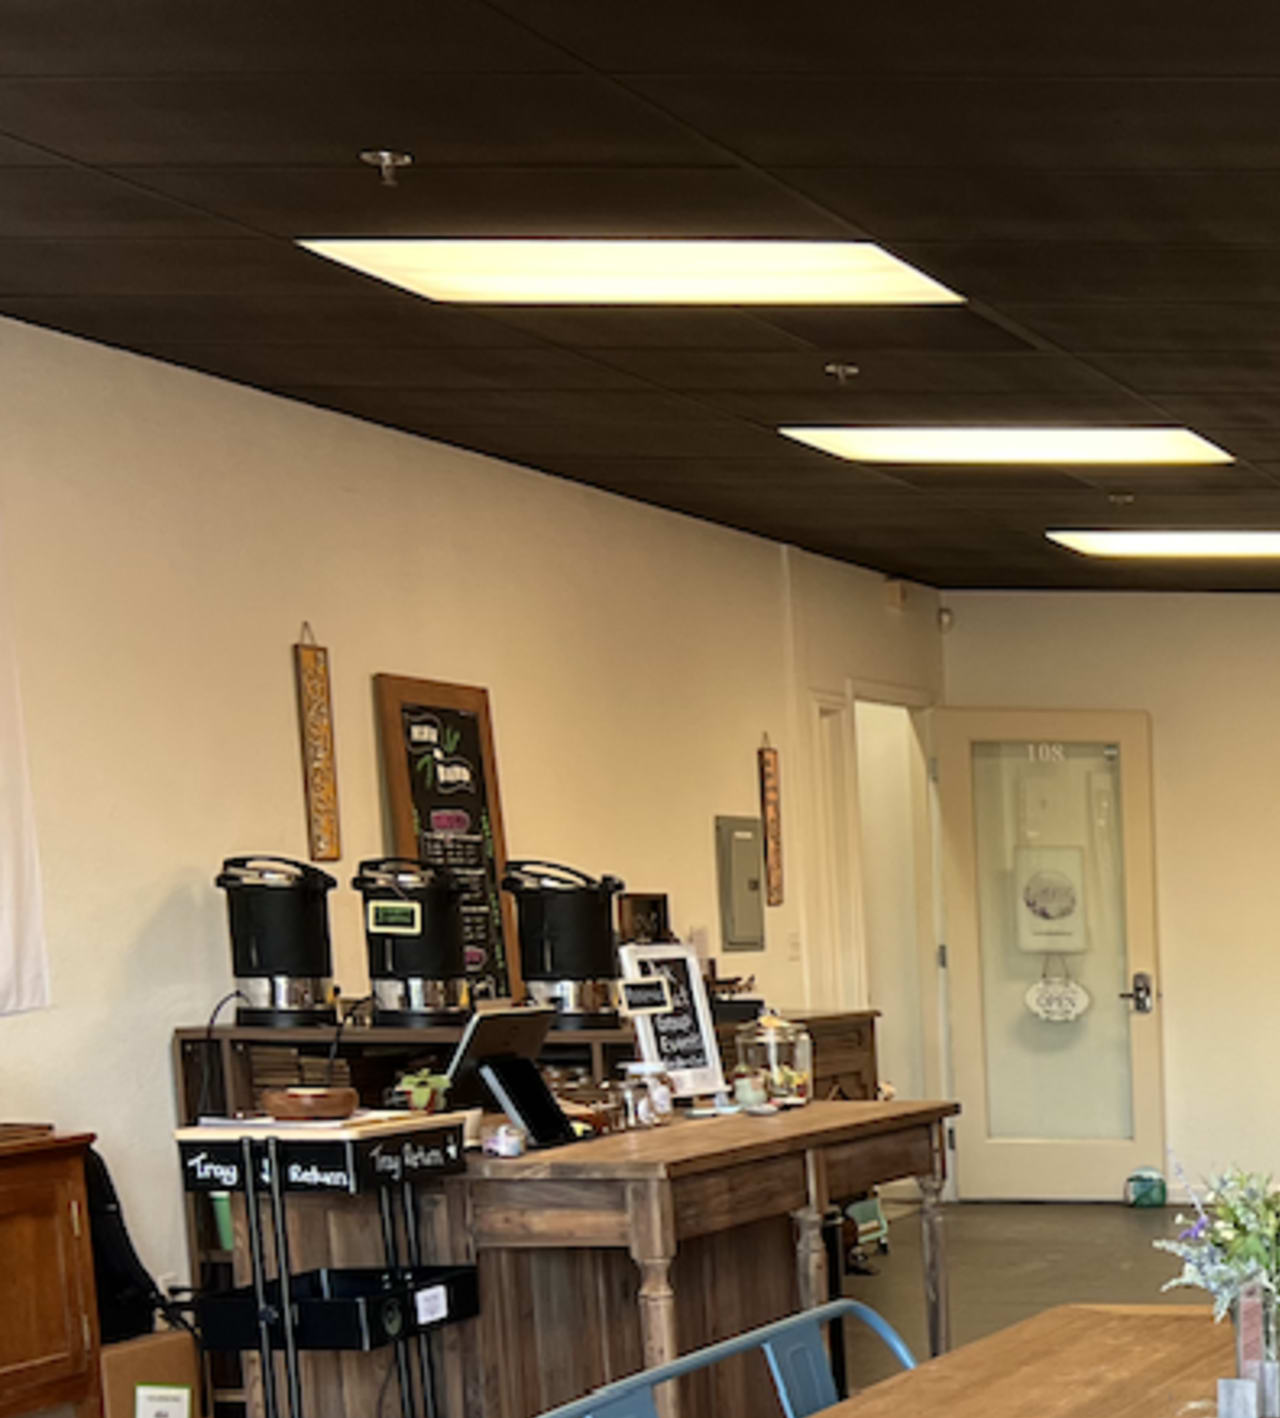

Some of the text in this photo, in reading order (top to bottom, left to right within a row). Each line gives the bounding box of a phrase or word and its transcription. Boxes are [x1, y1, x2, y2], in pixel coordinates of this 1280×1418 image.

[1025, 743, 1065, 762] 108
[187, 1152, 349, 1187] Tray Return
[370, 1144, 401, 1180] Tray
